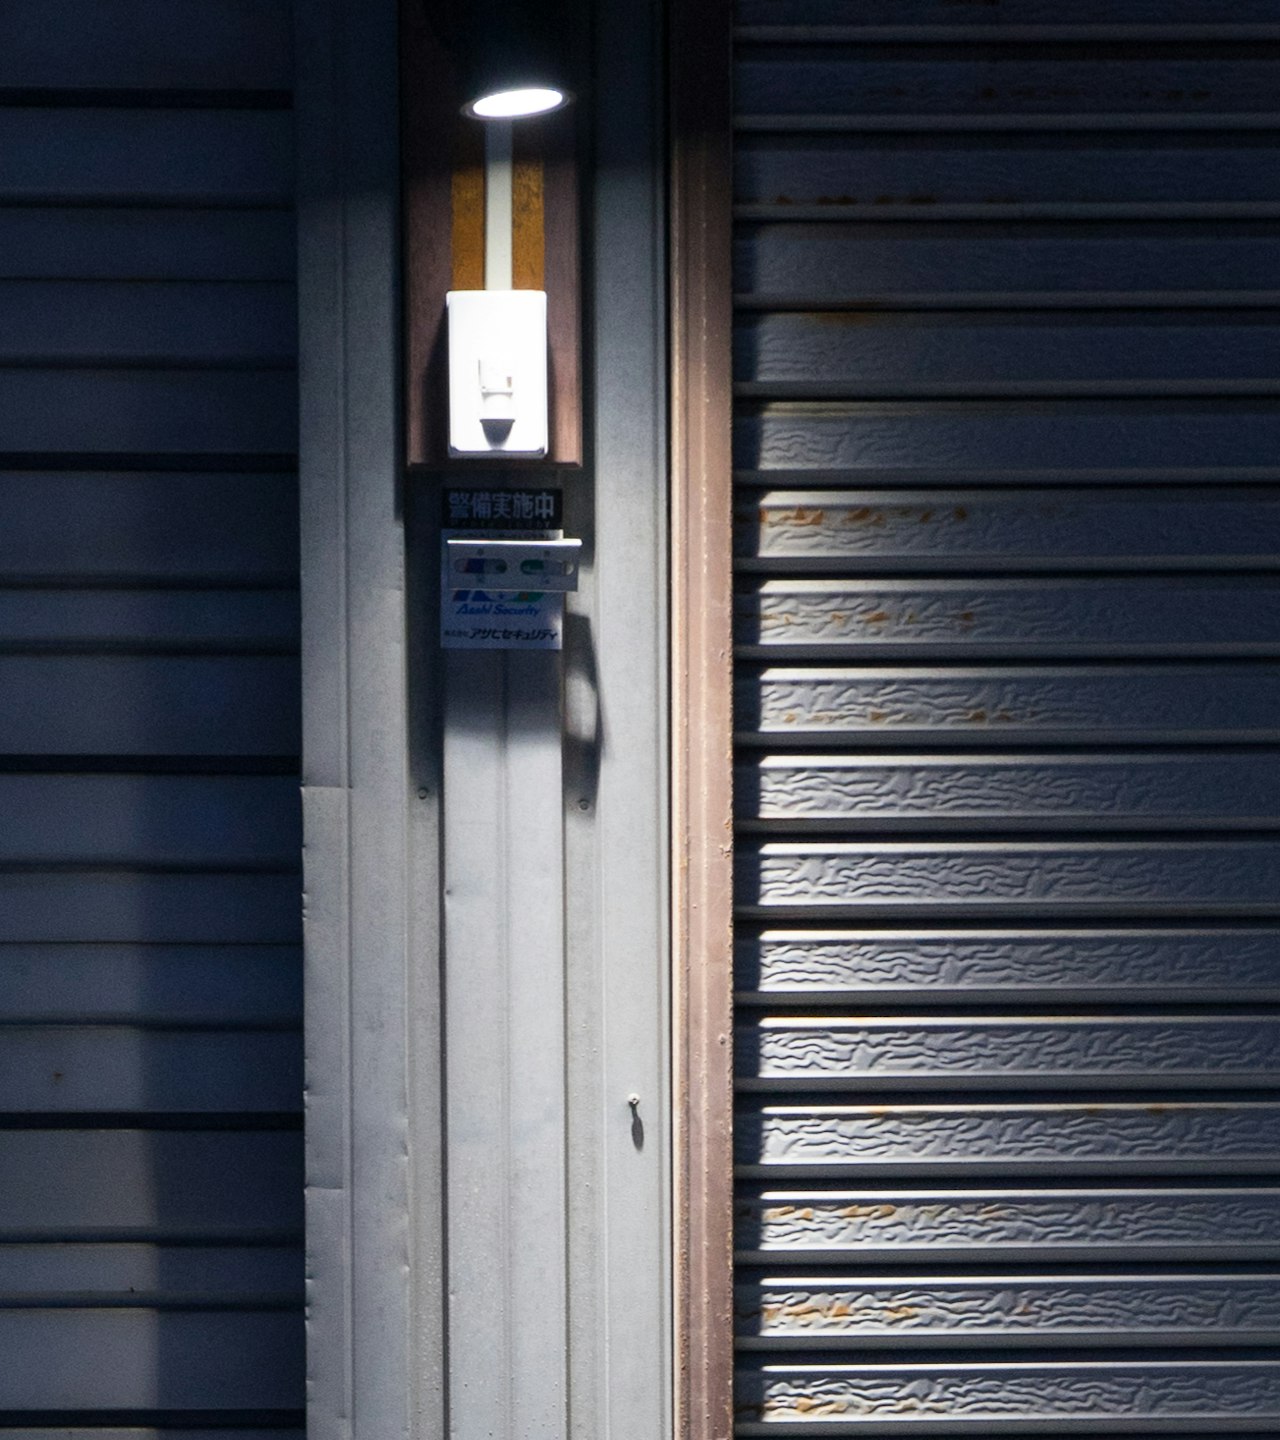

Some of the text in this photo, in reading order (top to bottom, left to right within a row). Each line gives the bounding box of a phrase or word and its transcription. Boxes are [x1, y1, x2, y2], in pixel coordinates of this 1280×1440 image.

[449, 491, 555, 519] 警備実施中
[493, 603, 542, 616] Security
[444, 628, 558, 641] アサヒセキュリティ
